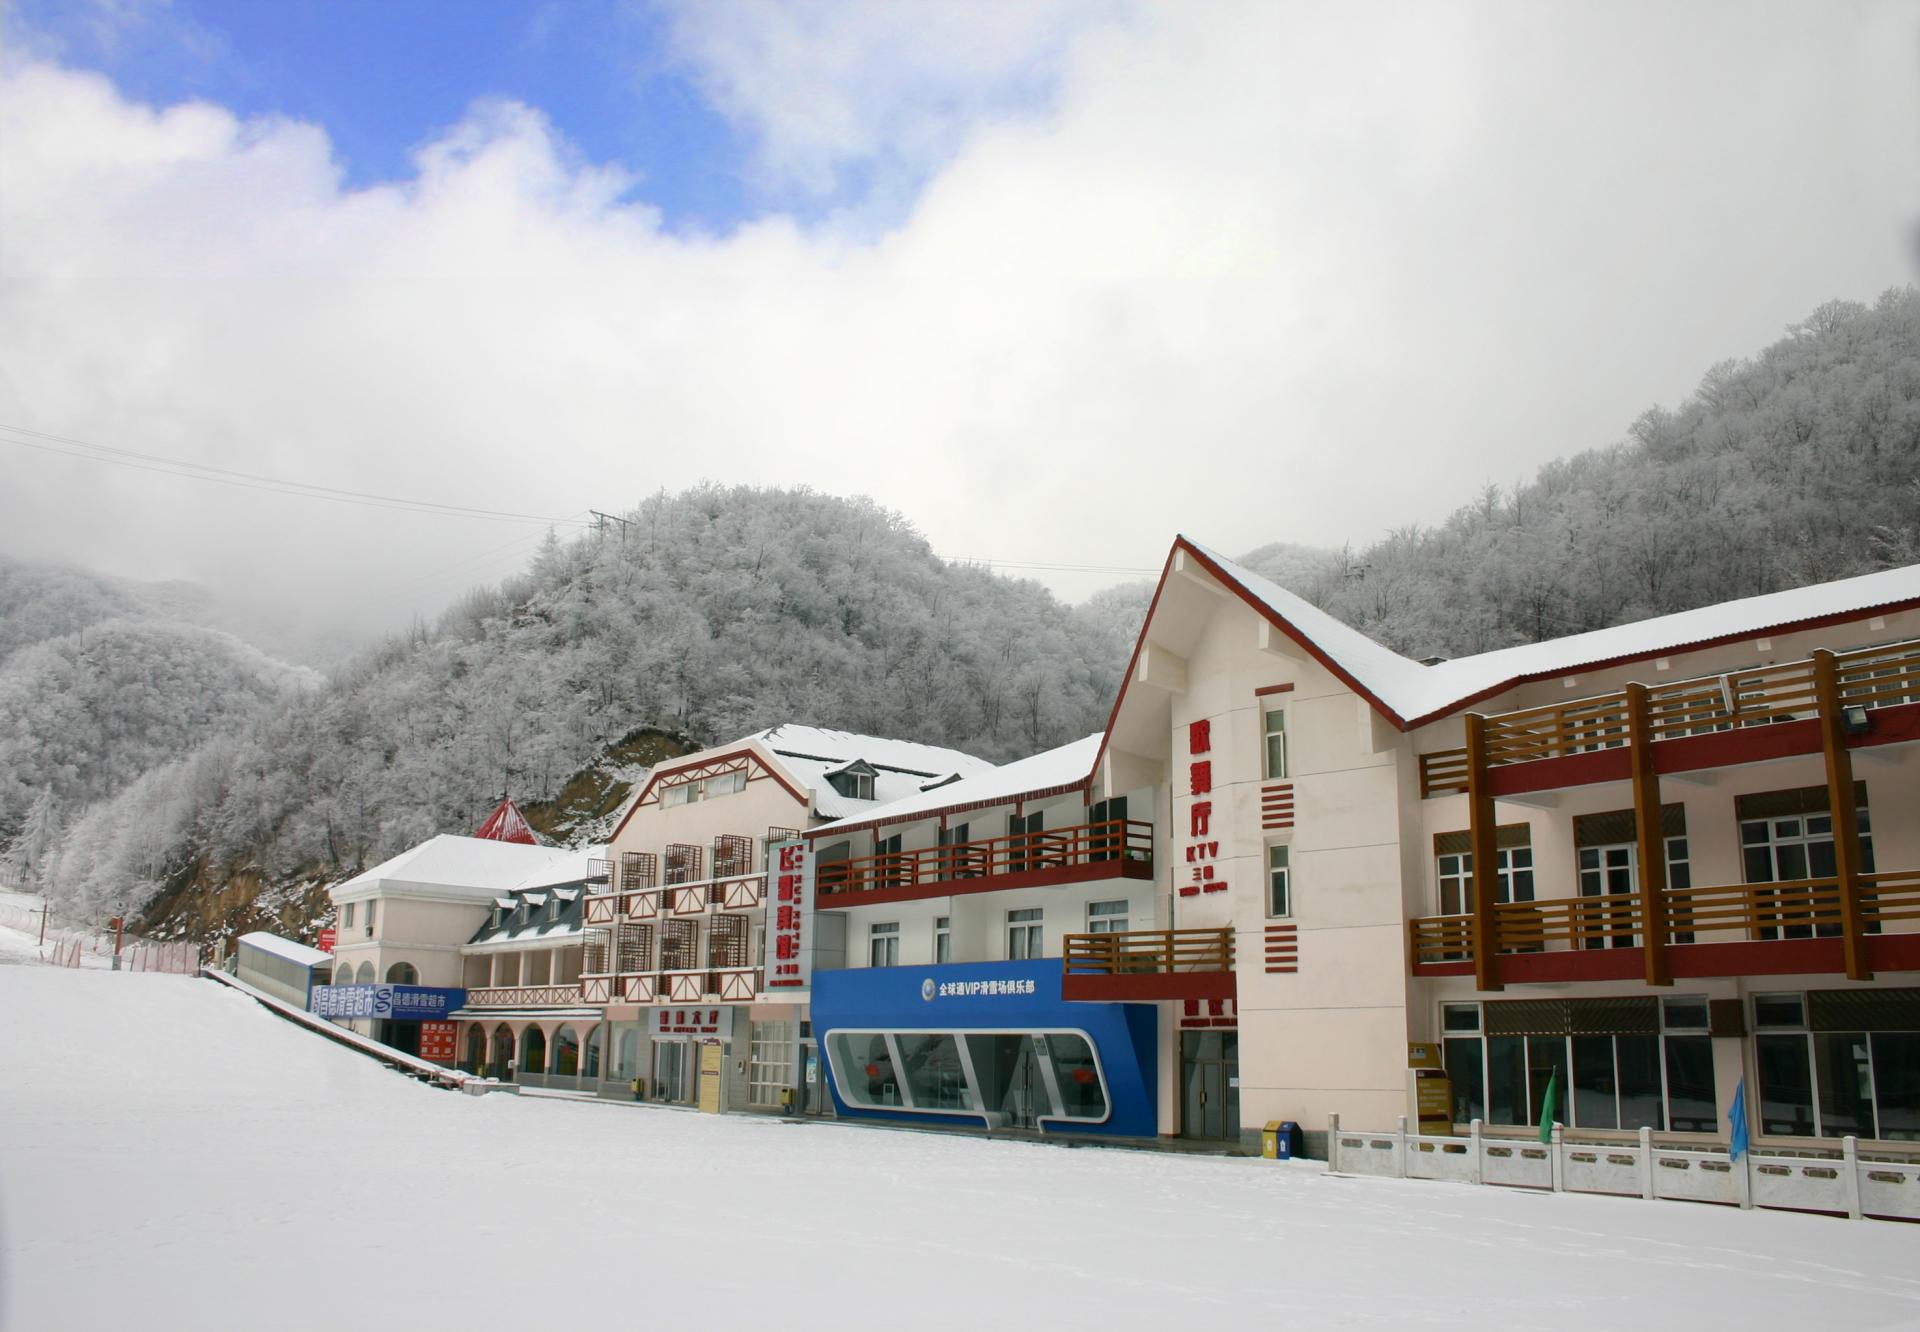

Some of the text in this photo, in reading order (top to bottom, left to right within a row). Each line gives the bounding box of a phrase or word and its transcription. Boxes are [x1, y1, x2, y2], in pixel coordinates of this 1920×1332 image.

[1186, 841, 1219, 863] KTV
[939, 980, 1035, 997] 全球通VIP滑雪场俱乐部
